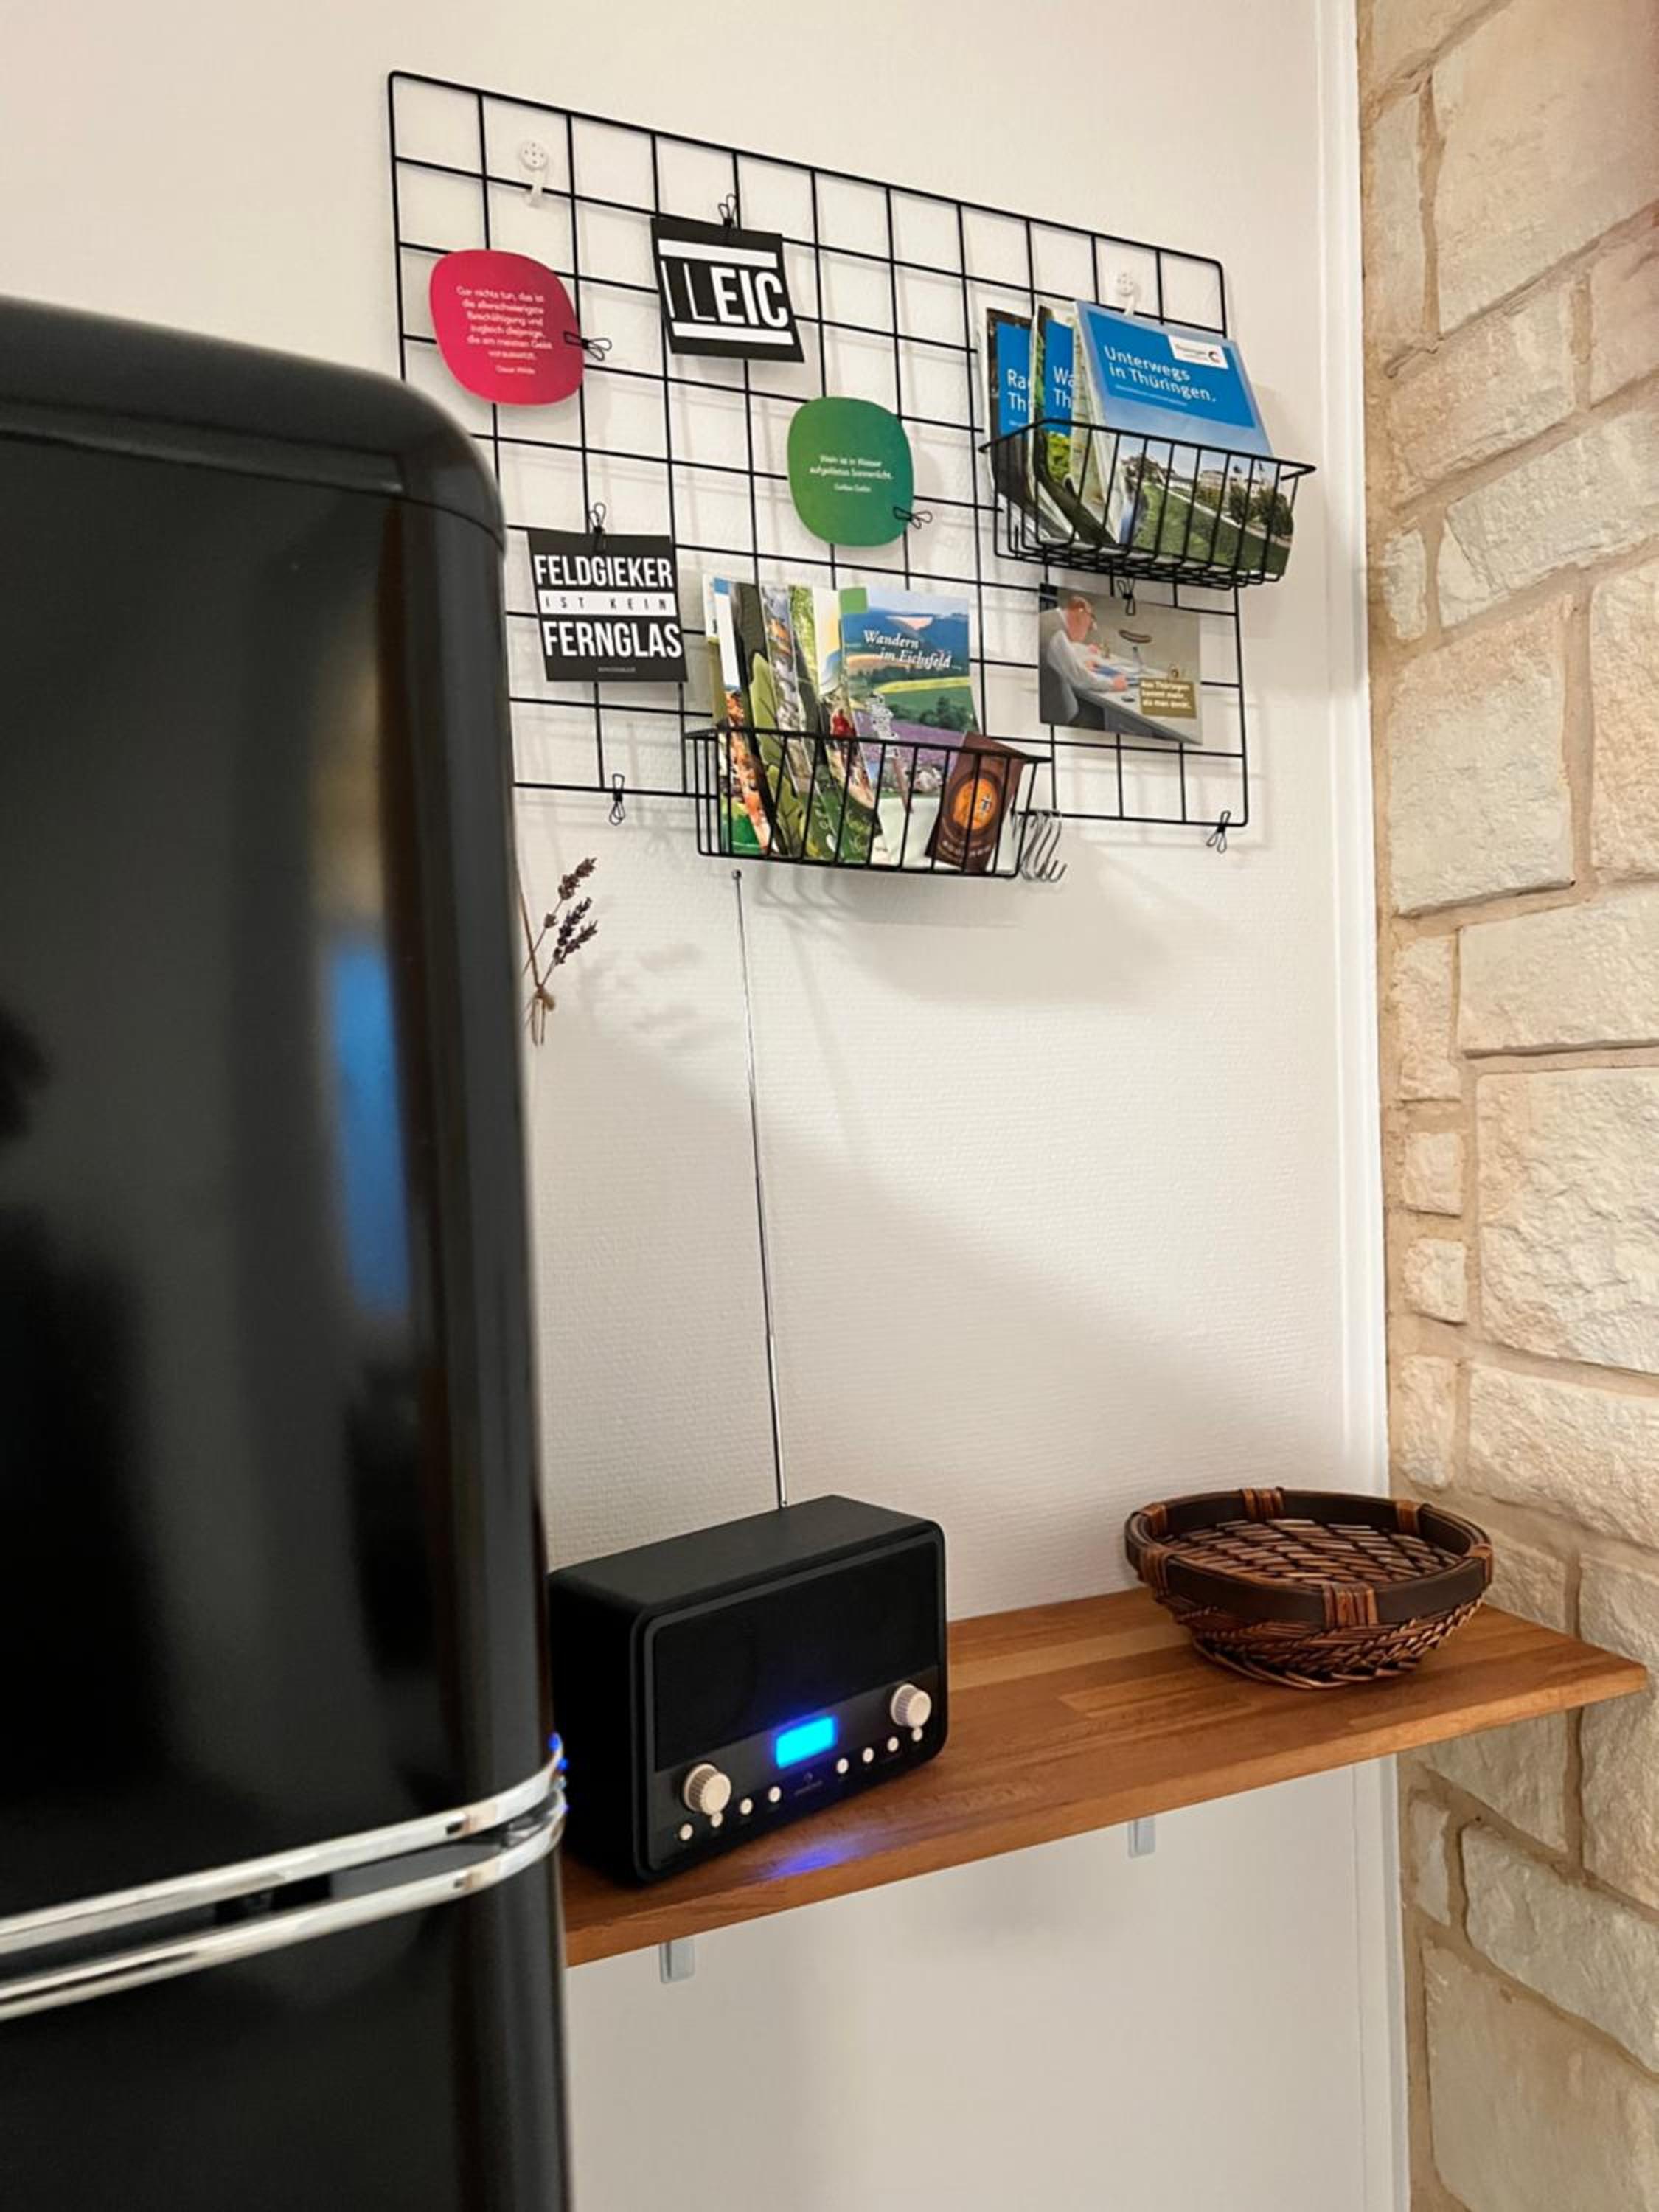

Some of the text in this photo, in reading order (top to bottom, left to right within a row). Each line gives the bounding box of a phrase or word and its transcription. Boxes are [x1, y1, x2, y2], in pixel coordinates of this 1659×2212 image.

[1104, 345, 1191, 383] Unterwegs
[1109, 362, 1126, 380] in
[1128, 367, 1217, 403] Thüringen.
[533, 555, 673, 588] FELDGIEKER
[546, 597, 667, 611] IST KEIN
[542, 621, 683, 658] FERNGLAS
[863, 629, 919, 649] Wandern
[879, 646, 952, 672] im Eichsfeld
